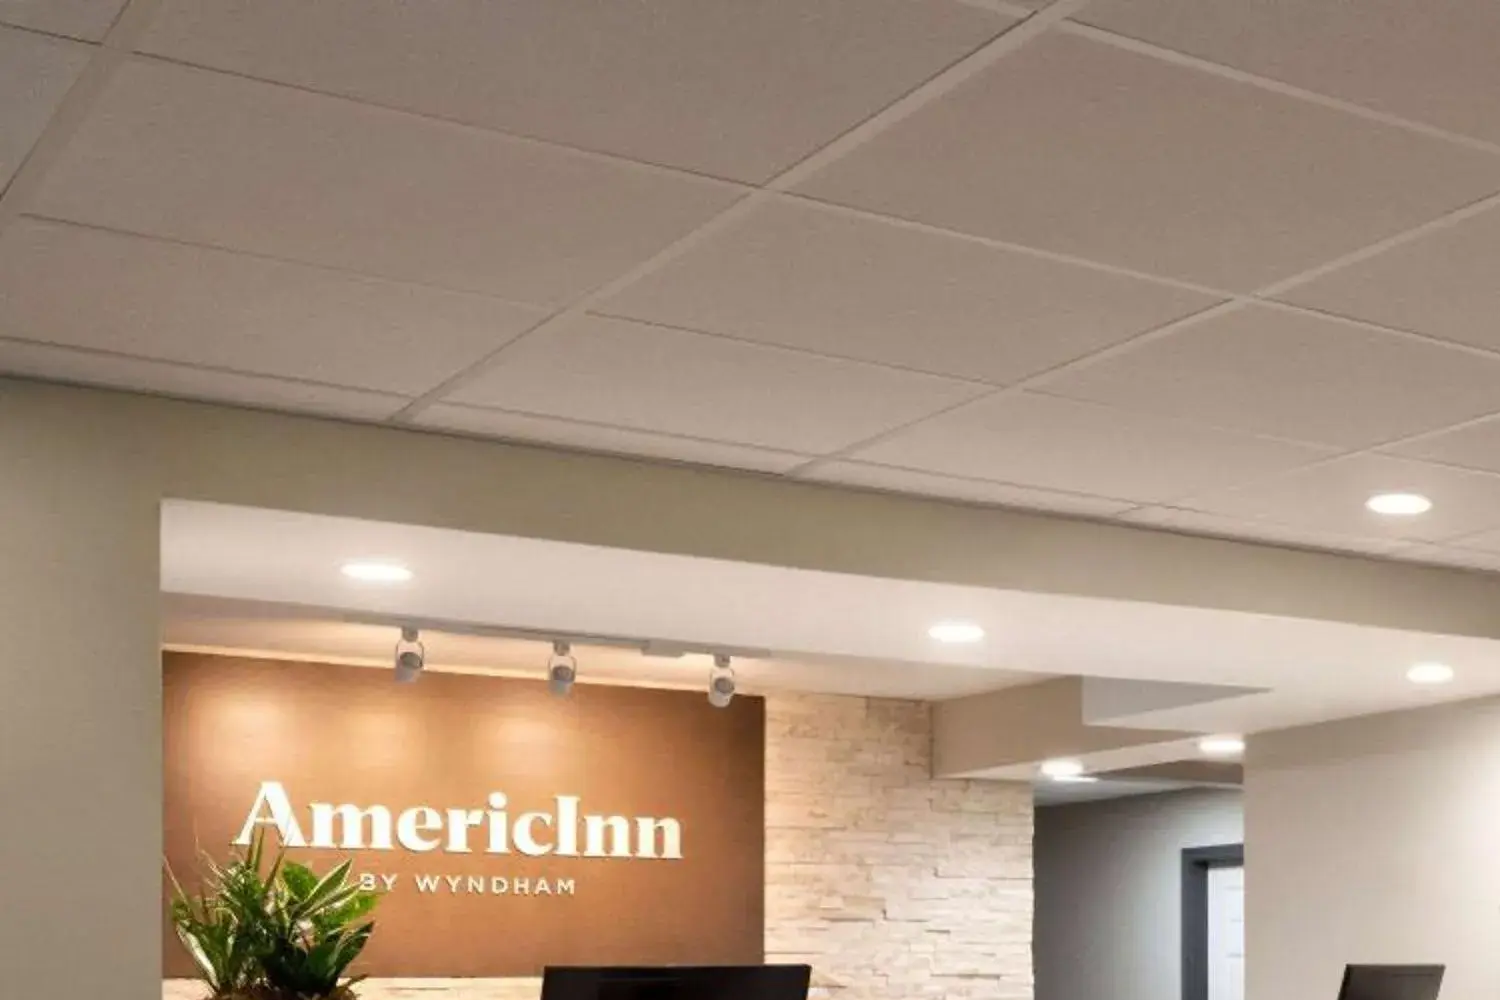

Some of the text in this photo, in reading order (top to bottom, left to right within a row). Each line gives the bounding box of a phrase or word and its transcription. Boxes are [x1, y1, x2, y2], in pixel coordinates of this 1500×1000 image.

[231, 780, 683, 859] AmericInn
[358, 873, 576, 895] BY WYNDHAM
